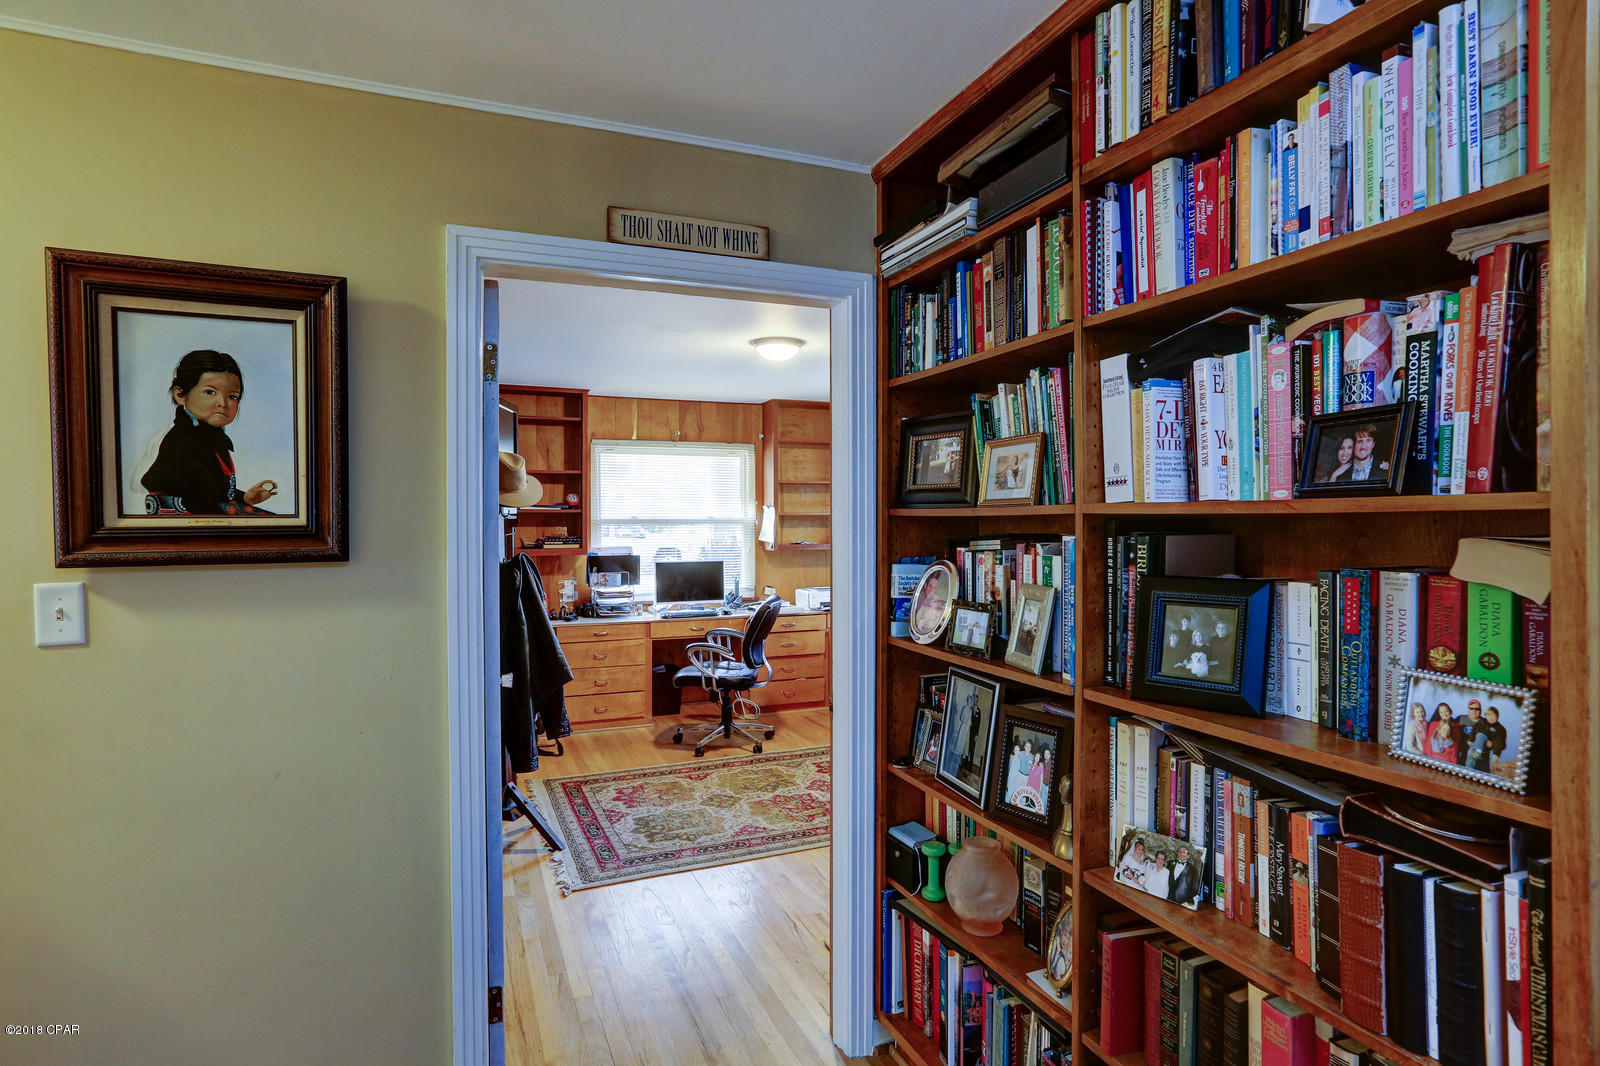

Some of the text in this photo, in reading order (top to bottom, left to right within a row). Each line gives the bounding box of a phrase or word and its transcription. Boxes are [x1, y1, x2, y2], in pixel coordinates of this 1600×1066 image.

[1141, 64, 1151, 110] TRUE JUSTICE
[1416, 88, 1424, 111] THIN
[1468, 12, 1478, 148] BEST DARN FOOD EVER!
[1384, 64, 1395, 169] WHEAT BELLY
[1402, 112, 1410, 126] Best
[1445, 89, 1455, 117] Complete
[1447, 118, 1457, 148] Cookbook
[1498, 108, 1507, 150] PIONEERS
[1152, 170, 1160, 200] GOOD
[1288, 156, 1296, 181] BELLY
[1401, 172, 1410, 190] Juices
[1161, 168, 1170, 210] Jane Brody's
[620, 214, 759, 254] THOU SHALT NOT WHINE
[1052, 224, 1060, 274] 1000
[1464, 310, 1472, 322] Oh
[1465, 292, 1473, 308] The
[1408, 342, 1420, 402] COOKING
[1462, 342, 1470, 368] Glows
[1477, 358, 1485, 372] Years
[1486, 344, 1496, 386] COOKBOOK
[1344, 372, 1370, 384] NEW
[1444, 344, 1456, 422] FORKS OVER KNIVES
[1460, 370, 1470, 410] Cookbook
[1474, 391, 1483, 404] Best
[1475, 380, 1484, 390] Our
[1417, 340, 1430, 460] MARTHA STEWART'S
[1472, 404, 1482, 424] Recipes
[1200, 432, 1208, 450] YOUR
[1442, 426, 1452, 476] THE COOKBOOK
[1108, 558, 1113, 566] OF
[1320, 578, 1329, 654] FACING DEATH
[1385, 594, 1394, 652] GABALDON
[1398, 608, 1408, 644] DIANA
[1434, 592, 1443, 642] GABALDON
[1444, 605, 1454, 634] DIANA
[1480, 588, 1488, 648] GABALDON
[1492, 602, 1502, 636] DIANA
[1276, 592, 1284, 692] Alexander Solzhenitsyn
[1528, 622, 1536, 663] GABALDON
[1266, 652, 1275, 692] WARD
[1342, 646, 1352, 706] COMPANION
[1350, 640, 1362, 706] OUTLANDISH
[1384, 670, 1392, 690] SNOW
[1384, 709, 1392, 732] ASHES
[1238, 832, 1246, 884] TENNESSEE HISTORY
[1276, 842, 1286, 896] Mary Stewart
[1508, 926, 1517, 960] InStyle
[914, 939, 922, 1013] DICTIONARY
[1530, 966, 1547, 1043] CHRISTMAS
